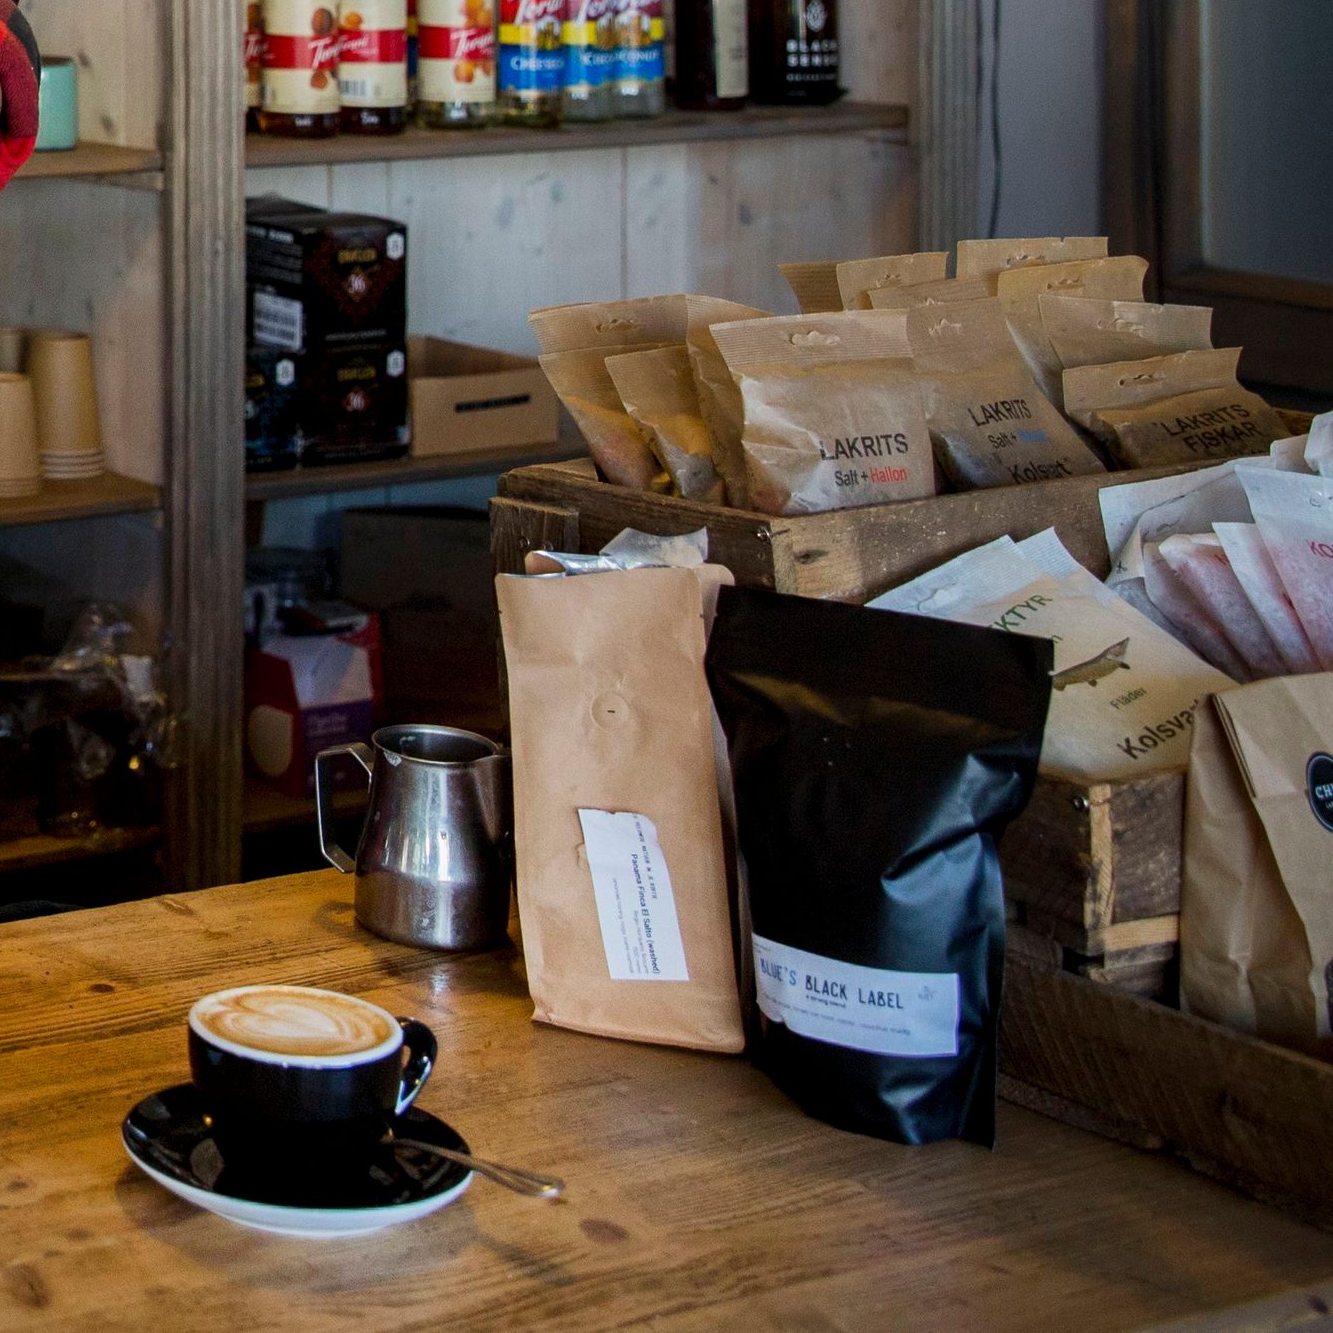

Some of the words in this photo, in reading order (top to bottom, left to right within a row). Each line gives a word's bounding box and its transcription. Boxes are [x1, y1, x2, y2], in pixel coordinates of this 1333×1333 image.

[967, 399, 1032, 426] LAKRITS
[1160, 404, 1251, 436] LAKRITS
[819, 433, 909, 461] LAKRITS
[988, 432, 1012, 448] Salt
[1182, 421, 1264, 452] FISKAR
[834, 469, 859, 486] Salt
[861, 471, 869, 482] +
[869, 467, 908, 483] Hallon
[987, 594, 1053, 632] KTYR
[631, 853, 642, 884] Panama
[643, 918, 652, 939] Salto
[646, 940, 661, 975] (washed)
[760, 958, 797, 986] BLUE'S
[805, 974, 848, 1000] BLACK
[858, 987, 904, 1010] LABEL
